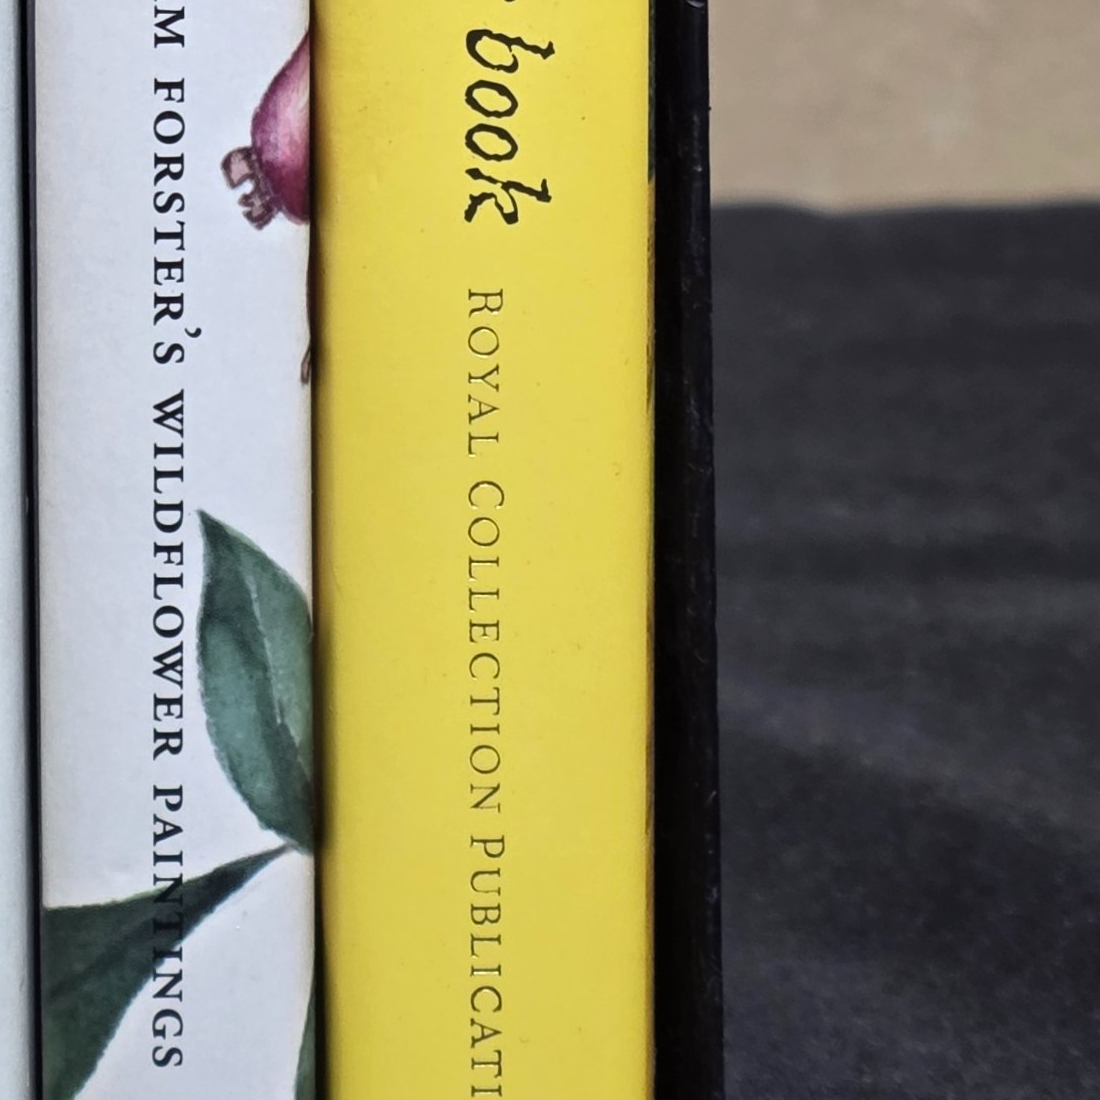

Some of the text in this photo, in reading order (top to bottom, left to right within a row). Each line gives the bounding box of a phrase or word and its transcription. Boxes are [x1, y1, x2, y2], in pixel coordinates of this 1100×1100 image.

[151, 76, 204, 366] FORSTER'S
[462, 27, 557, 226] book
[151, 386, 187, 761] WILDFLOWER
[466, 287, 506, 1100] ROYAL COLLECTION PUBLICATI
[151, 783, 186, 1069] PAINTINGS
